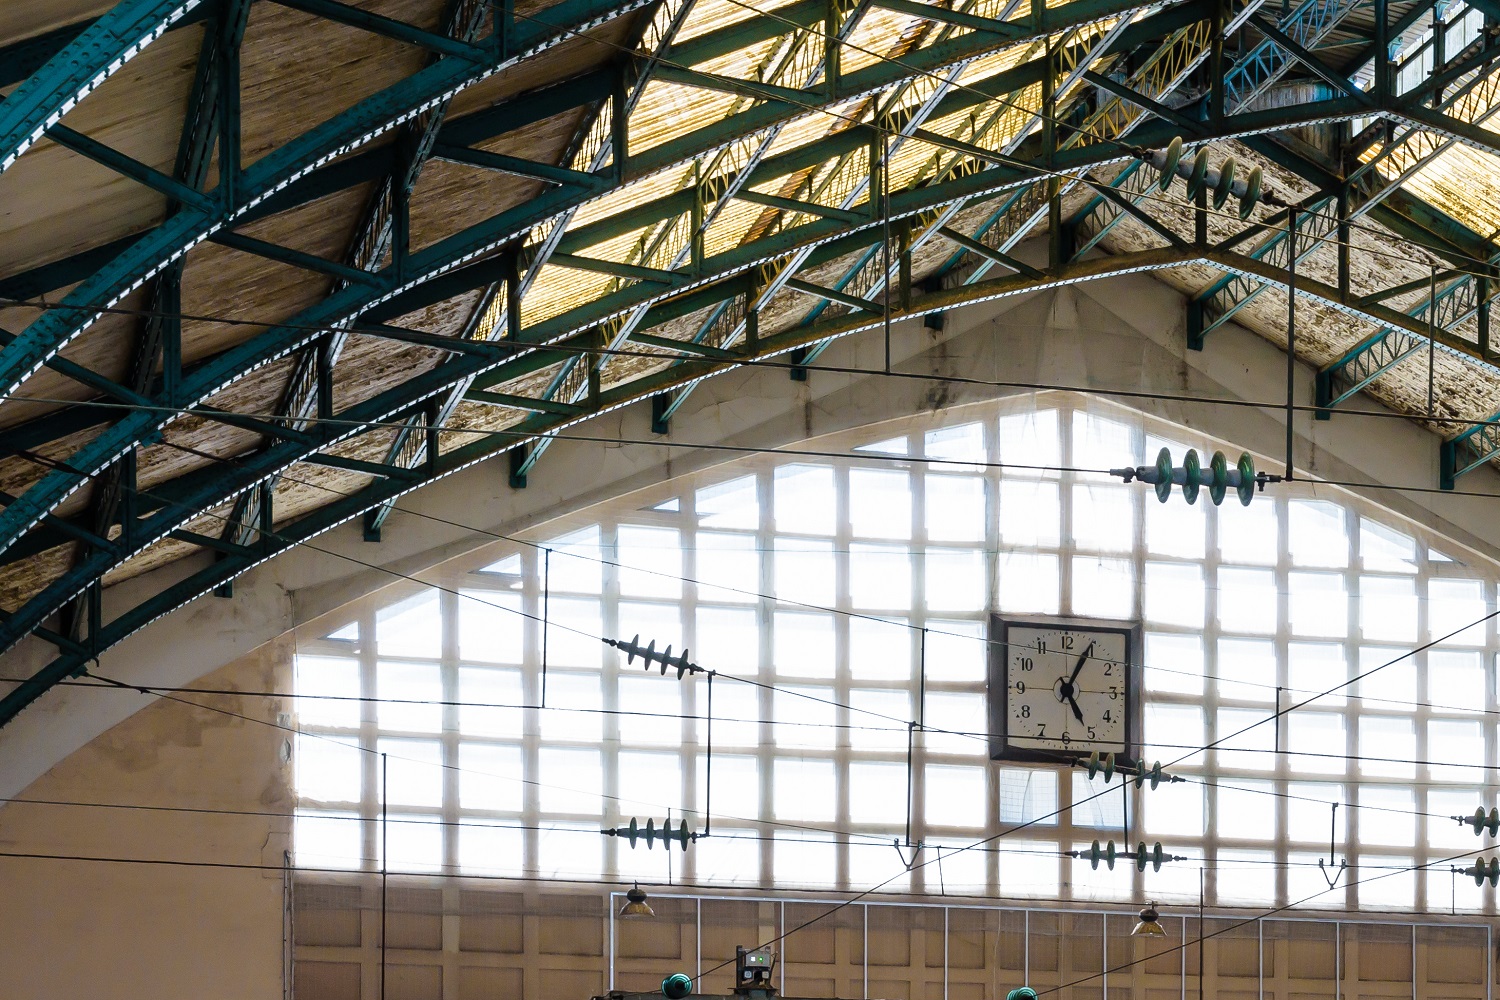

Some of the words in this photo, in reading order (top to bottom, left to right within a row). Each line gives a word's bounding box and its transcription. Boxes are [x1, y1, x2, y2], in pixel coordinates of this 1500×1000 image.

[1037, 639, 1046, 655] 11
[1061, 635, 1074, 650] 12
[1020, 657, 1033, 672] 10
[1103, 662, 1112, 677] 2
[1016, 680, 1026, 695] 9
[1108, 686, 1118, 700] 3
[1021, 704, 1031, 719] 8
[1102, 709, 1112, 723] 4
[1037, 723, 1047, 737] 7
[1087, 726, 1096, 740] 5
[1061, 731, 1071, 745] 6
